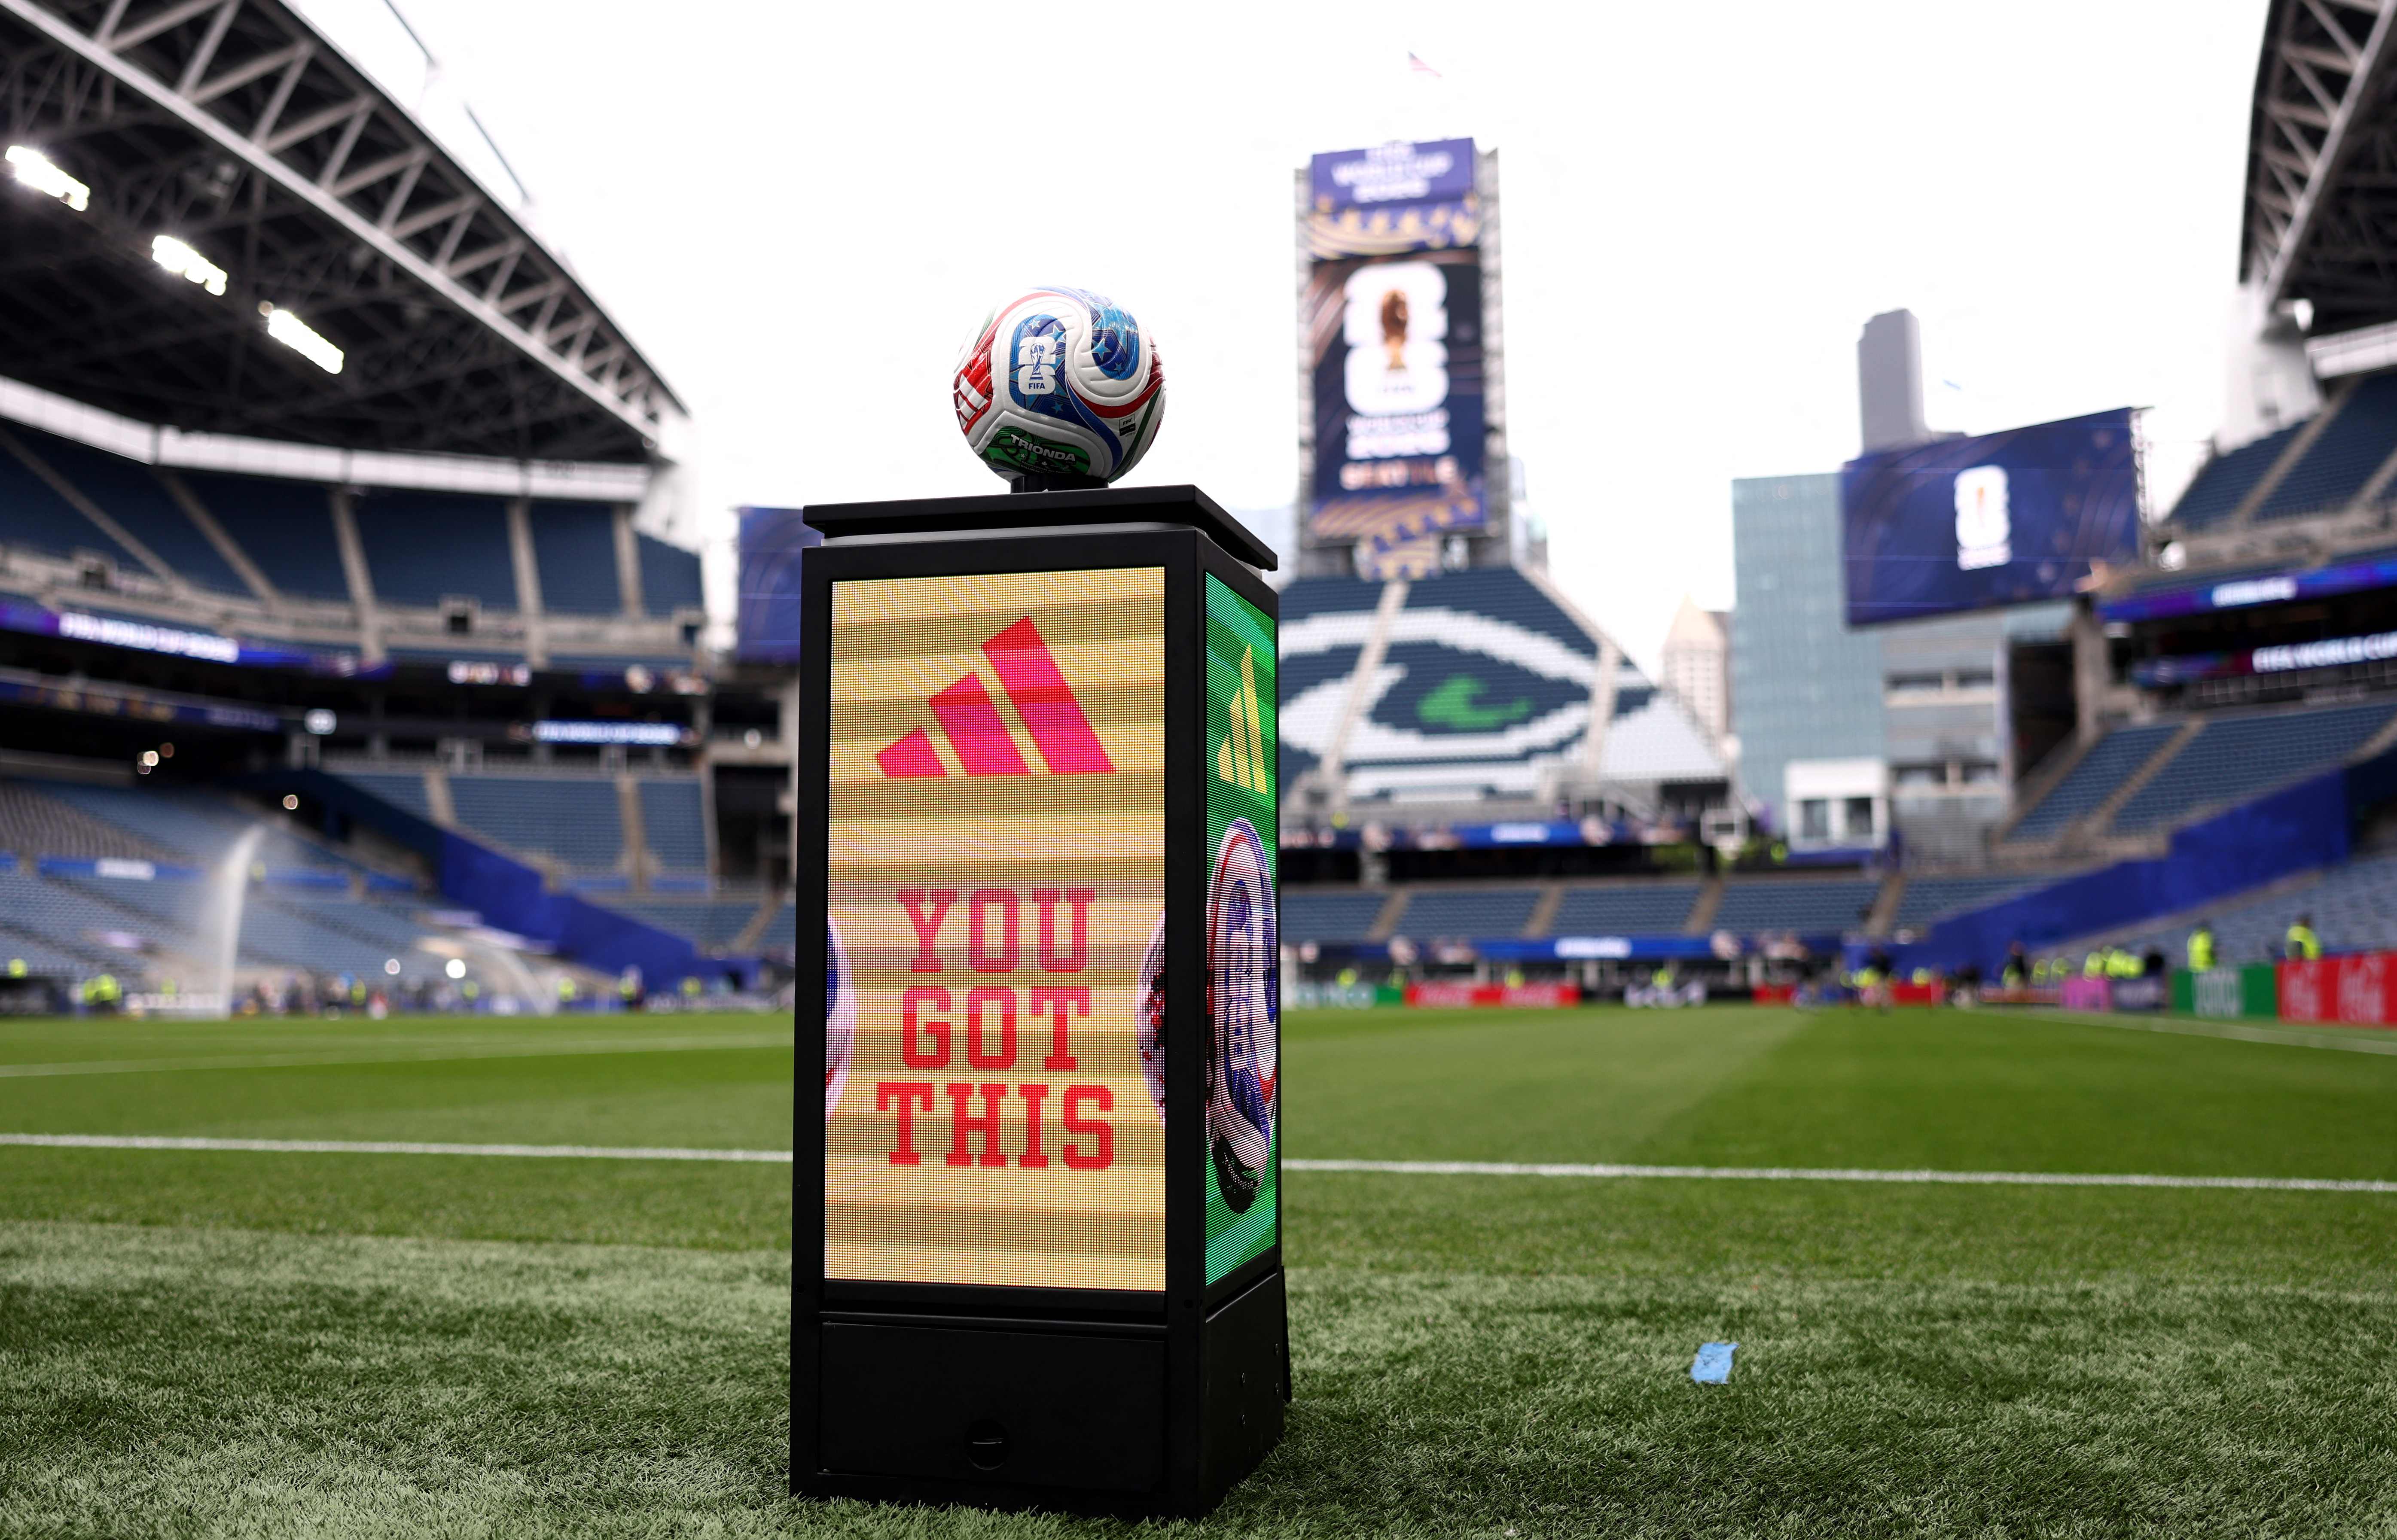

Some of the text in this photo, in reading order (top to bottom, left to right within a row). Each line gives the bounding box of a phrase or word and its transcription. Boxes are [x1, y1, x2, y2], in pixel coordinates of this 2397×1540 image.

[1010, 434, 1076, 462] TRIONDA
[896, 888, 1095, 973] YOU
[903, 986, 1090, 1072] GOT
[877, 1082, 1114, 1170] THIS
